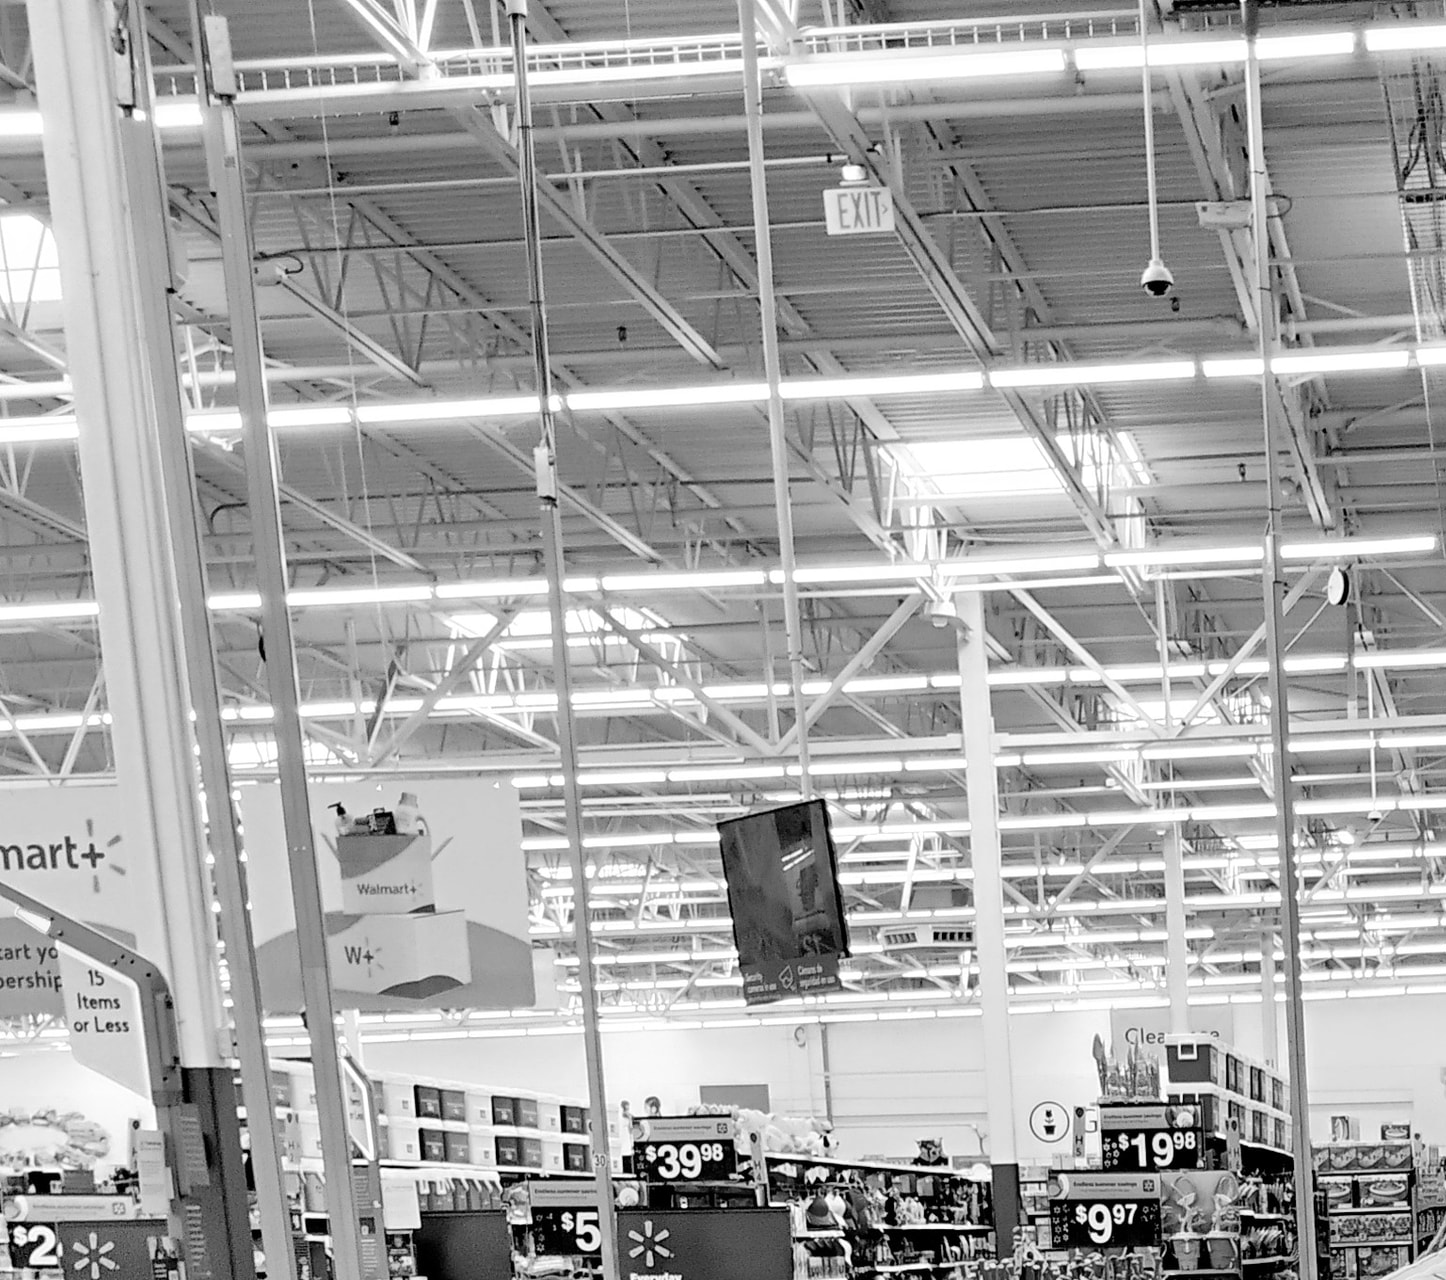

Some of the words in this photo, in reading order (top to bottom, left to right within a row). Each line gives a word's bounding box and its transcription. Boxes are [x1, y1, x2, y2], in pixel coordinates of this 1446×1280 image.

[837, 192, 881, 229] EXIT
[0, 943, 31, 961] art
[88, 969, 105, 986] 15
[76, 992, 121, 1010] Items
[73, 1020, 90, 1033] or
[94, 1016, 130, 1033] Less
[594, 1154, 606, 1167] 30
